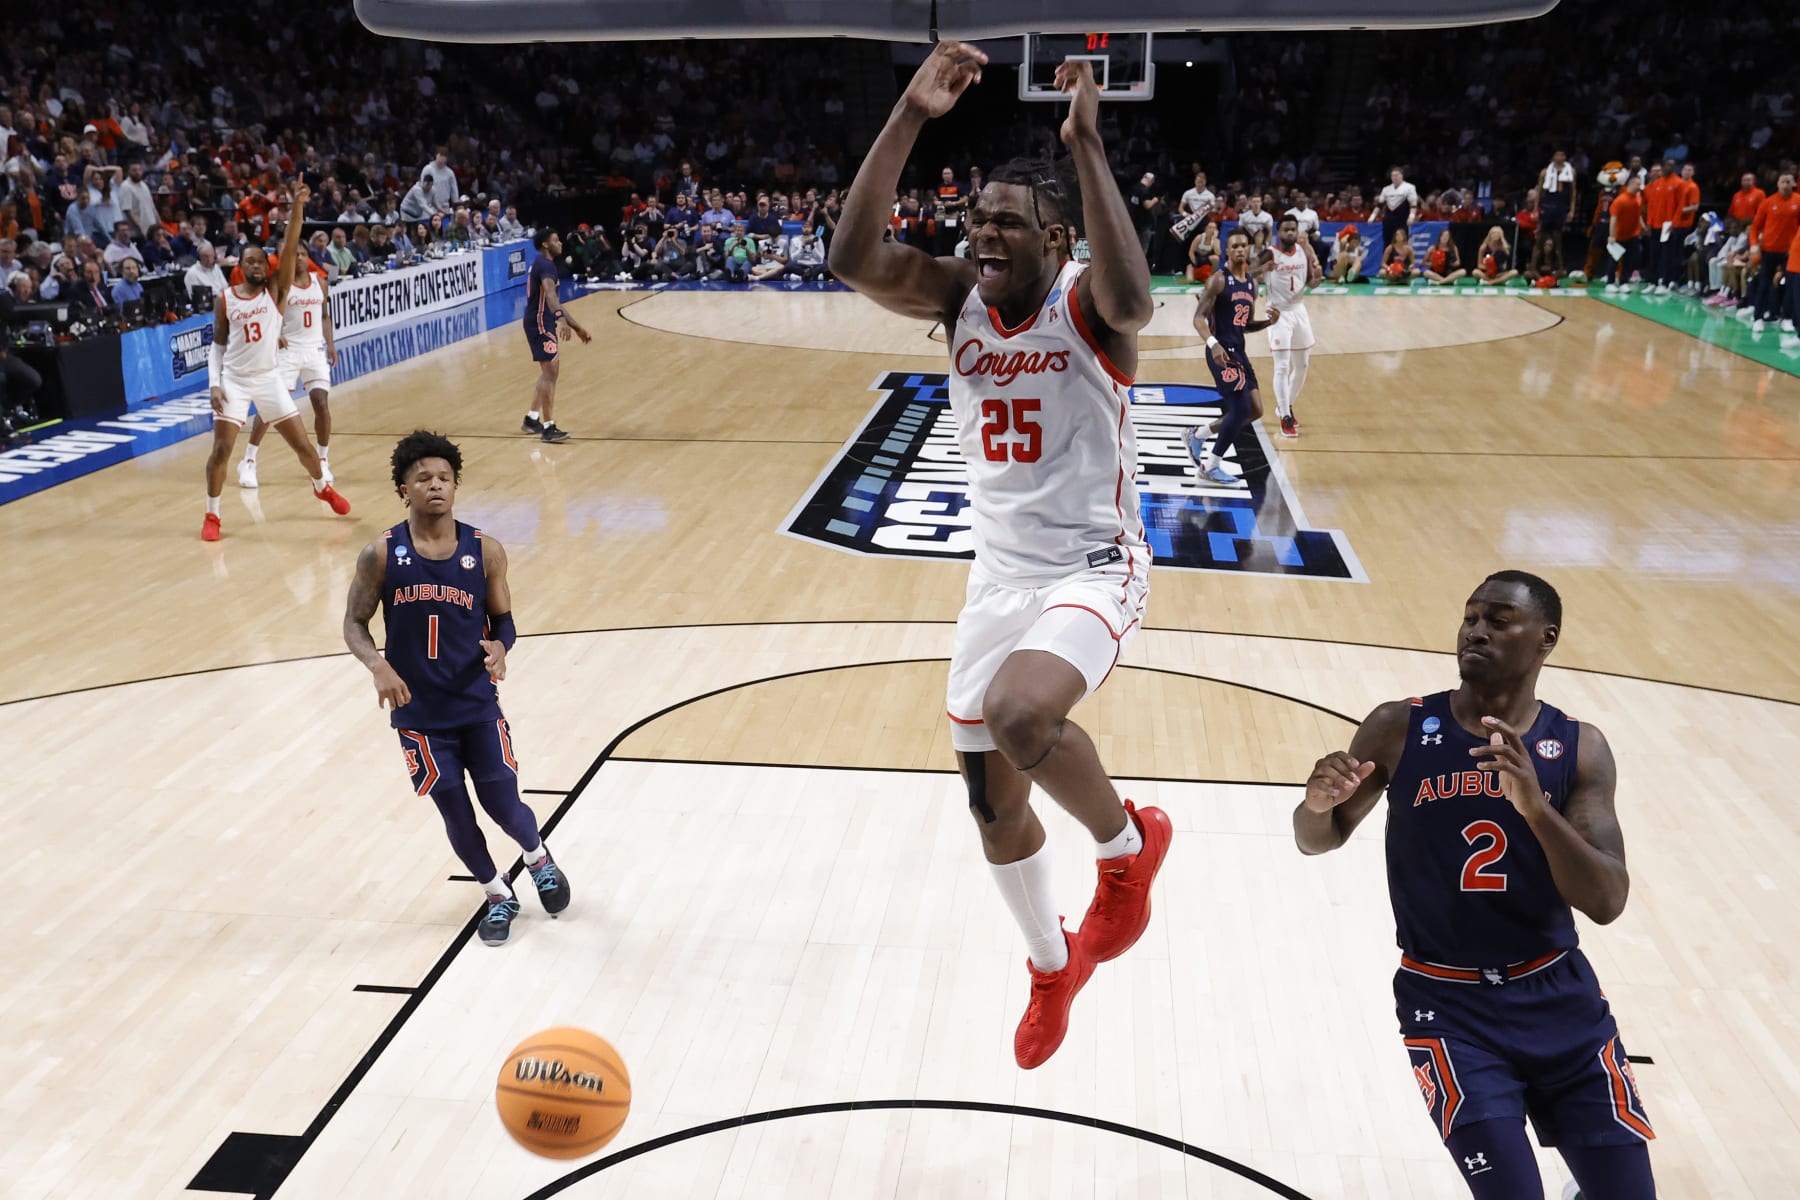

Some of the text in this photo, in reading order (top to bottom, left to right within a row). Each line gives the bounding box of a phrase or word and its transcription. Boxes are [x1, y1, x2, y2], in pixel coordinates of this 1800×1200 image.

[327, 260, 478, 330] UTHEASTERN CONFERENCE
[1289, 276, 1295, 292] 1
[243, 321, 263, 344] 13
[1233, 304, 1250, 327] 22
[955, 338, 1070, 387] Cougars
[980, 398, 1043, 463] 25
[393, 583, 475, 611] AUBURN
[427, 614, 439, 660] 1
[1537, 739, 1562, 758] SEC
[1413, 770, 1552, 808] AUBU
[1459, 819, 1509, 893] 2
[515, 1056, 605, 1094] Wilson
